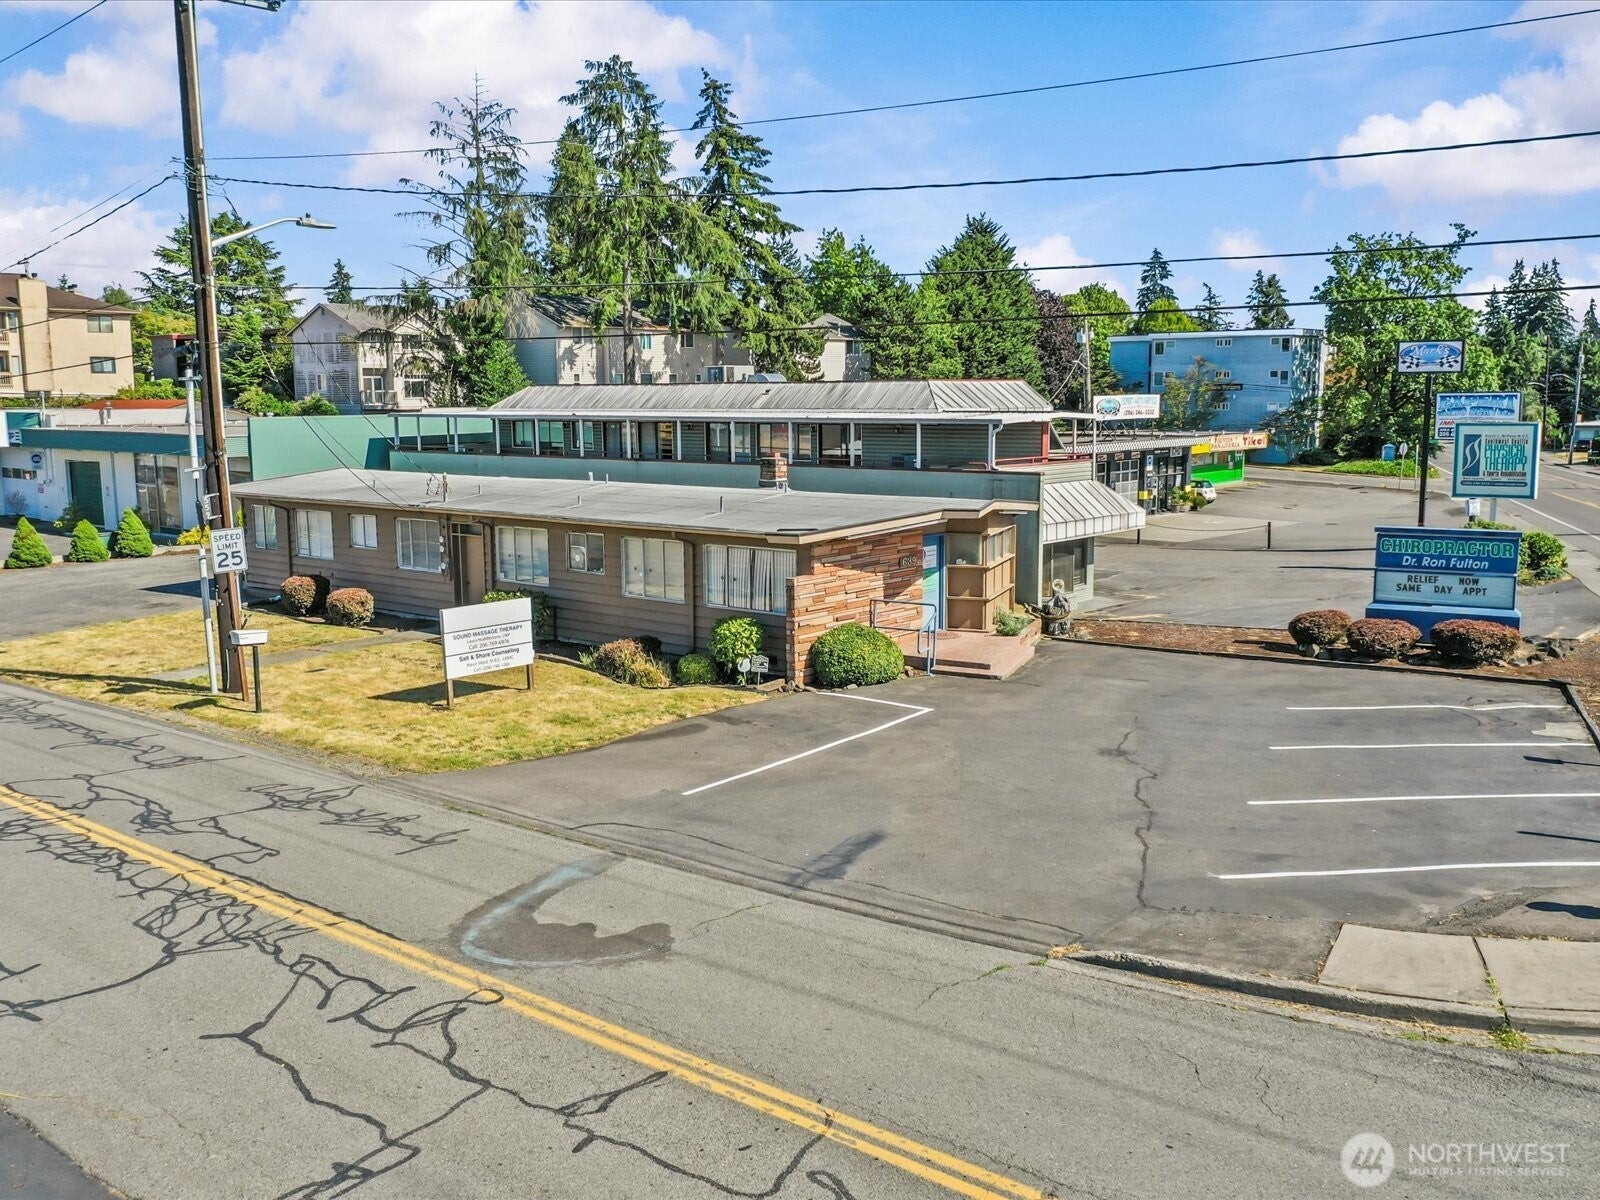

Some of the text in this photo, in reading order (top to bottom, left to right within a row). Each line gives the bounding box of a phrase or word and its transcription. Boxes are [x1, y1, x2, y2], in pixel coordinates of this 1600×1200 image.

[1439, 394, 1517, 409] EXPERT
[1484, 444, 1527, 458] PHYSICAL
[1484, 456, 1527, 471] THERAPY
[213, 533, 241, 542] SPEED
[1380, 538, 1514, 558] CHIROPRACTOR
[216, 551, 243, 569] 25
[1402, 555, 1489, 570] Dr. Ron Fulton
[1407, 574, 1480, 586] RELIEF NOW
[1396, 583, 1488, 596] SAME DAY APPT
[453, 633, 471, 641] SOUND
[473, 629, 498, 638] MASSAGE
[475, 651, 491, 660] Shore
[492, 647, 519, 657] Counseling
